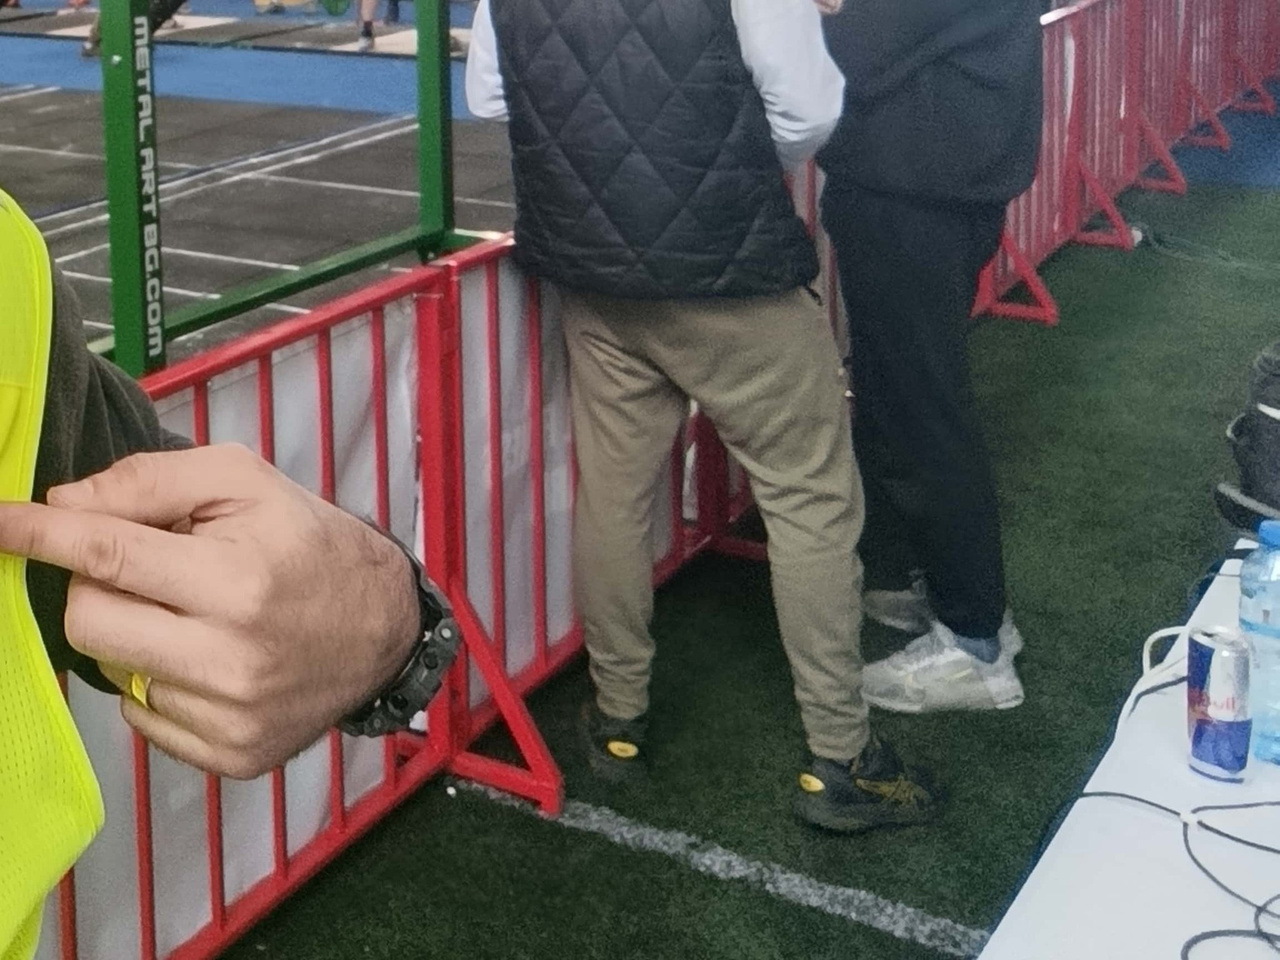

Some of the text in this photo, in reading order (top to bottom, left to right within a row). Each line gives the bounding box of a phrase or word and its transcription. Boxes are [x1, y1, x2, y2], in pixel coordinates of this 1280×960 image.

[134, 16, 163, 357] METAL ART BG.COM
